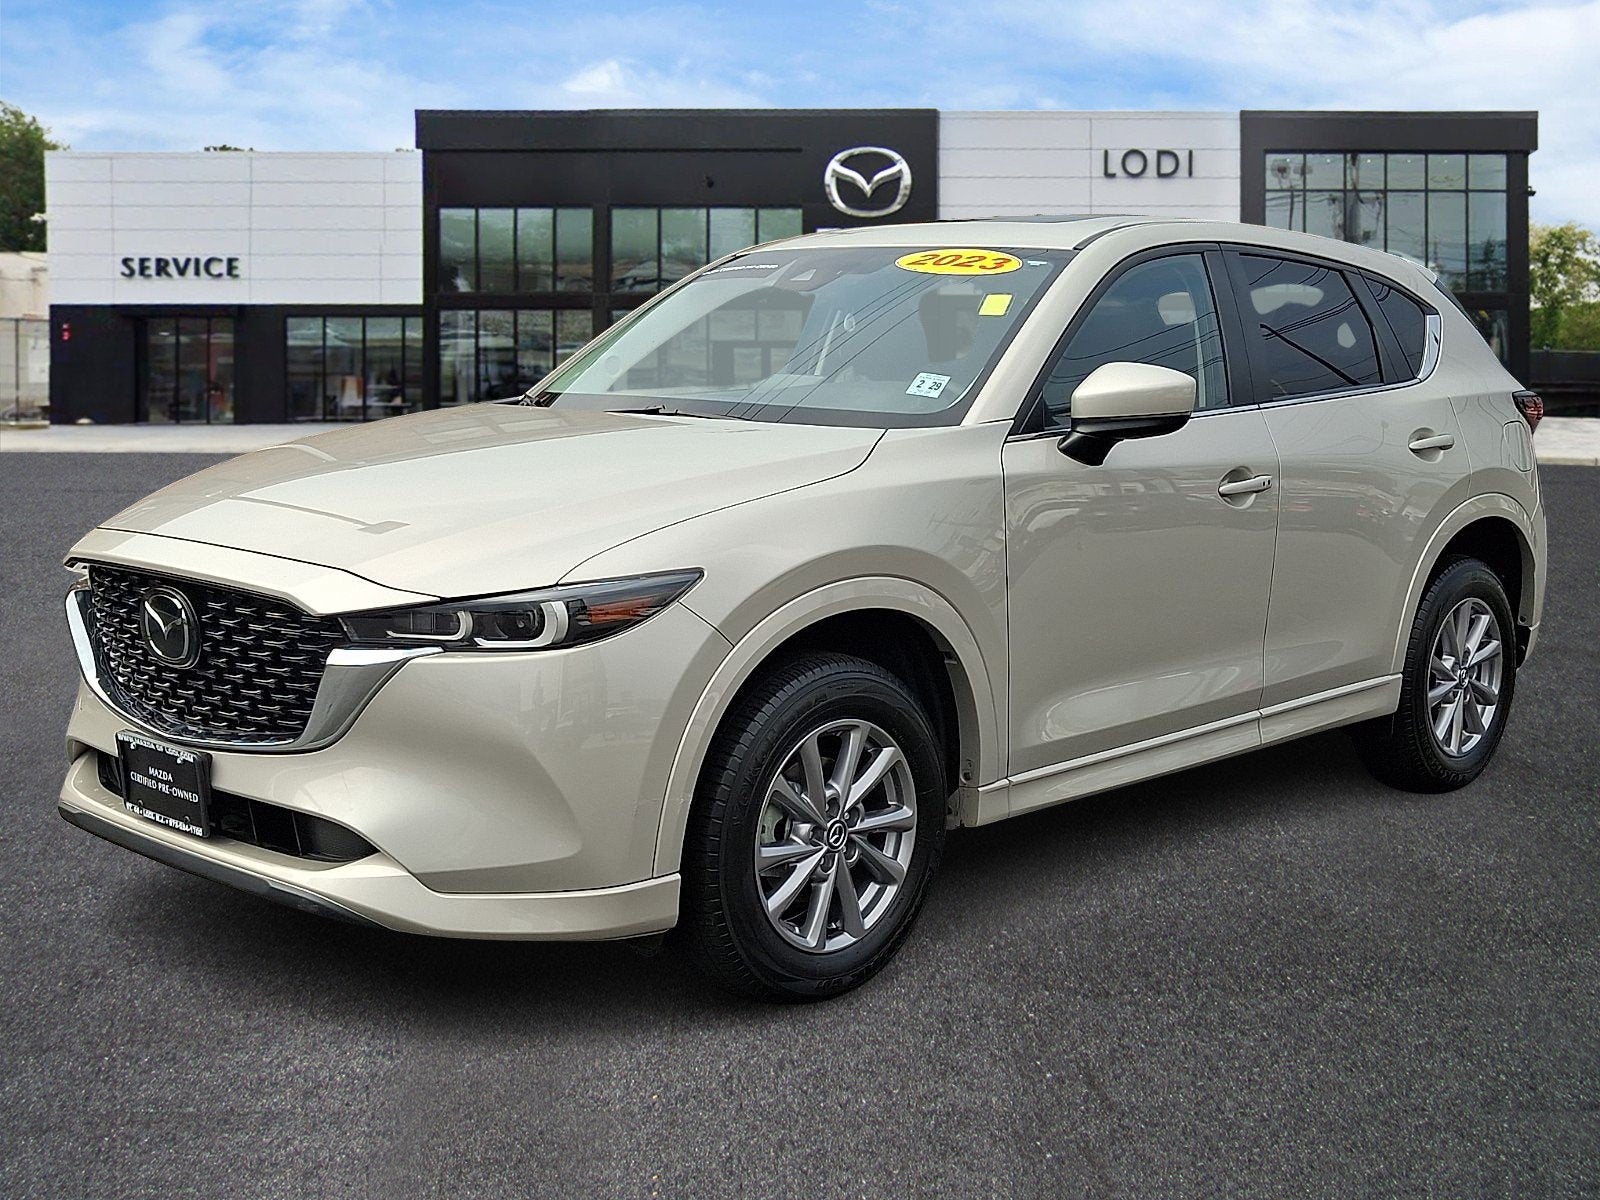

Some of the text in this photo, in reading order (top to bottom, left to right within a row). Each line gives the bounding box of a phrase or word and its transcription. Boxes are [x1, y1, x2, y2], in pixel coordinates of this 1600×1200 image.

[1103, 149, 1193, 178] LODI
[120, 256, 240, 278] SERVICE
[906, 254, 1012, 270] 2023
[916, 380, 942, 391] 2 29
[148, 766, 173, 782] MAZDA
[130, 771, 199, 803] CERTIFIED PRE-OWNED
